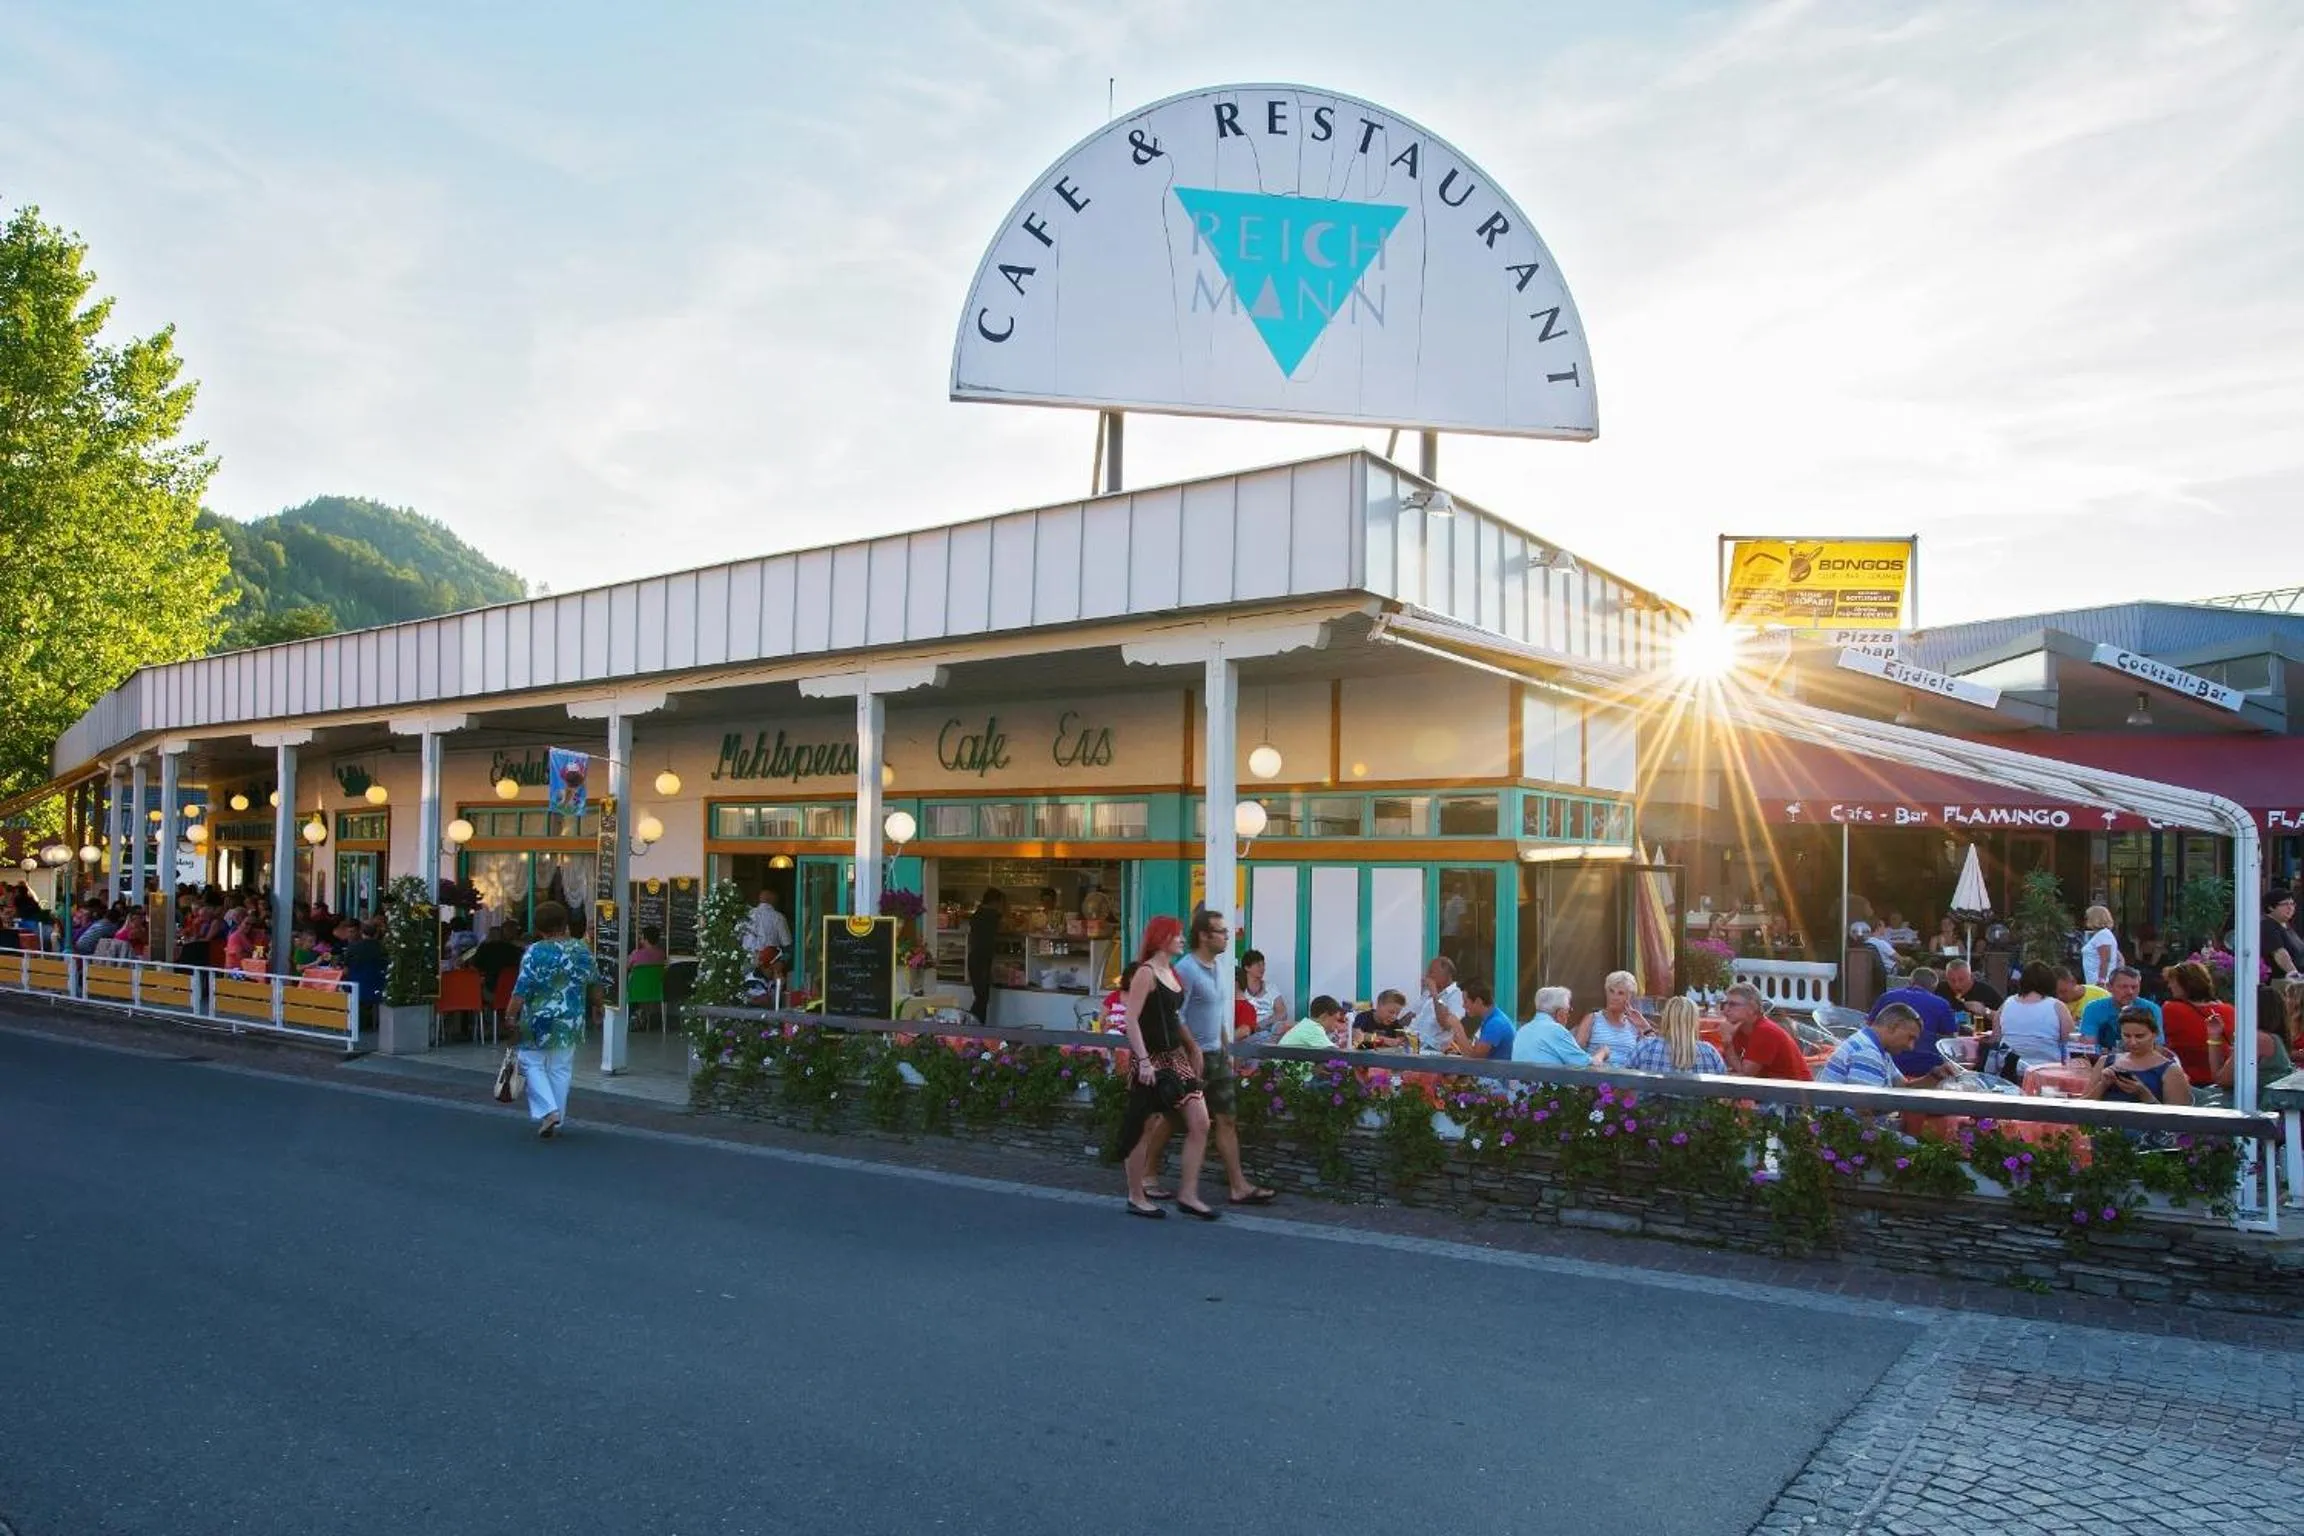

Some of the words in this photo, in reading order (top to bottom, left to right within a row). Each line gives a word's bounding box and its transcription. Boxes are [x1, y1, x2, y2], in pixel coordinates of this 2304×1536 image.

[978, 175, 1090, 343] CAFE
[1128, 128, 1164, 165] &
[1214, 100, 1579, 388] RESTAURANT
[1192, 211, 1386, 271] REICH
[1818, 559, 1905, 571] BONGOS
[1836, 631, 1893, 643] Pizza
[2117, 653, 2228, 702] Cocktail-Bar
[1053, 710, 1113, 767] Eis
[1830, 804, 1873, 821] Cafe
[1895, 807, 1928, 824] Bar
[1943, 806, 2070, 828] FLAMINGO
